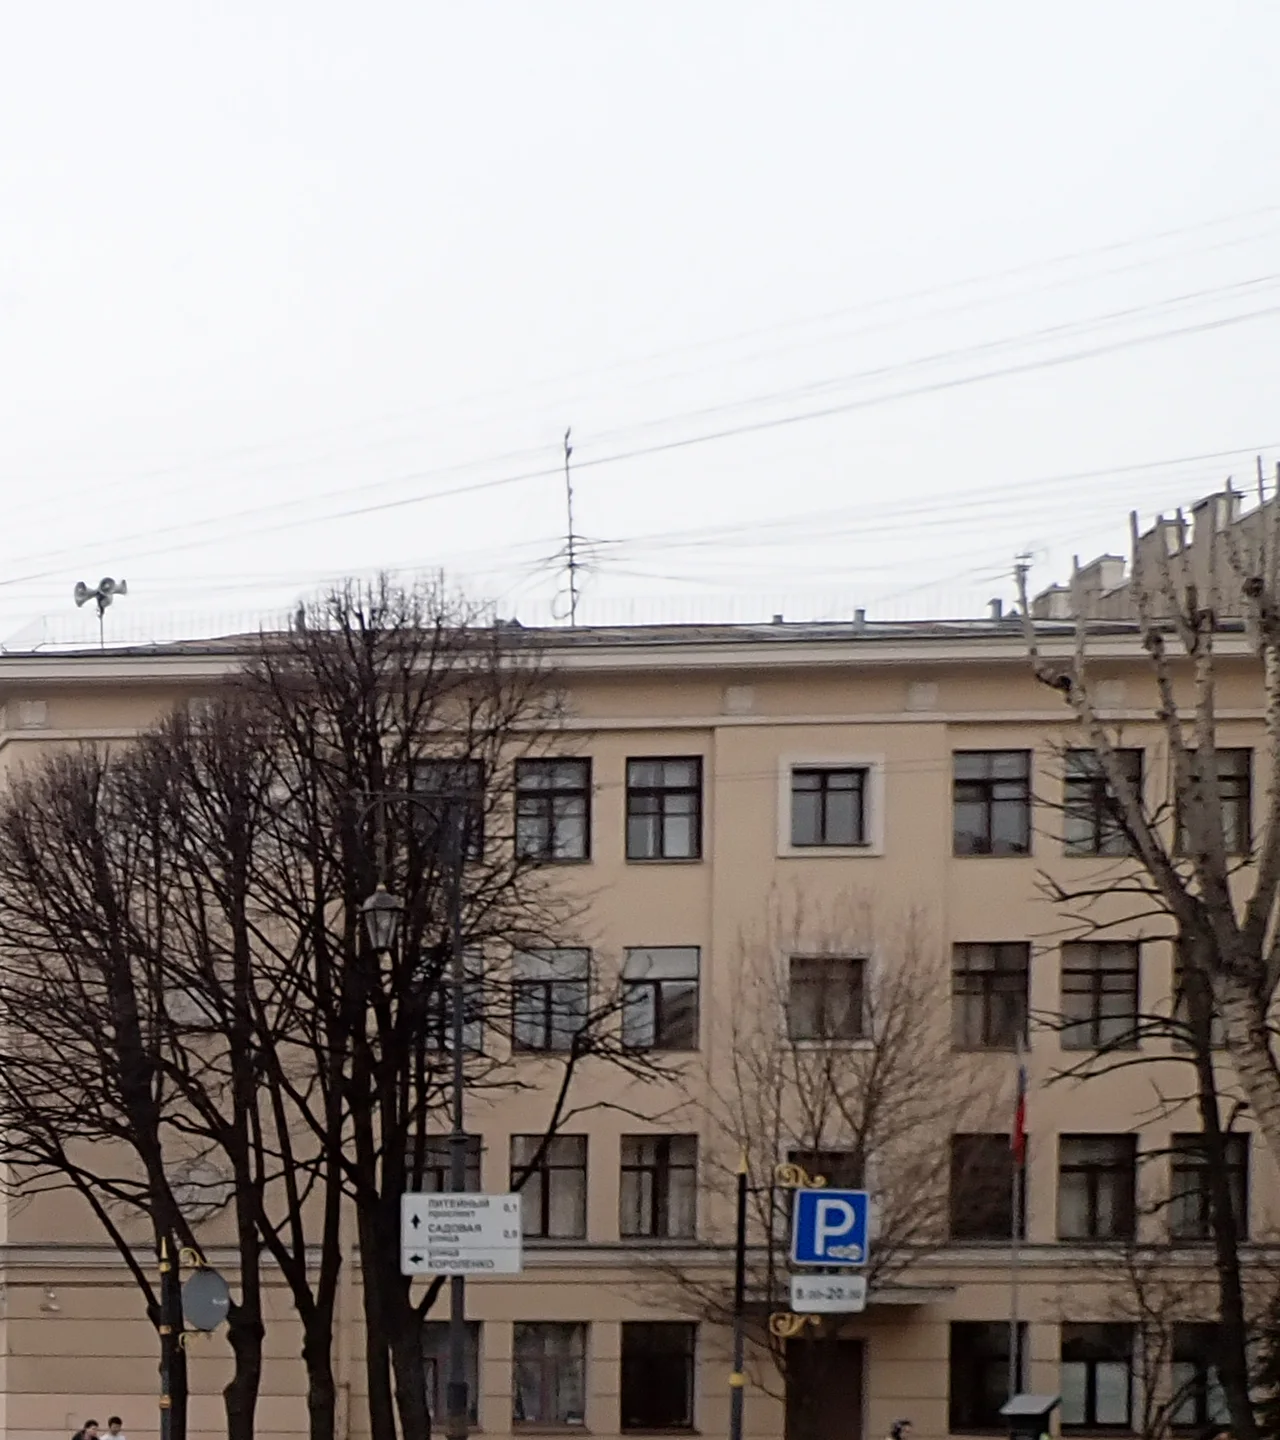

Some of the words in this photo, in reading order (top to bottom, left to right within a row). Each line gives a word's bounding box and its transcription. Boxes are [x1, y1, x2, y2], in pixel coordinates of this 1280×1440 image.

[428, 1198, 490, 1208] ЛИТЕЙНЫЙ
[428, 1223, 482, 1233] САДОВАЯ
[428, 1235, 460, 1244] улица
[428, 1259, 495, 1269] КОРОЛЕНКО
